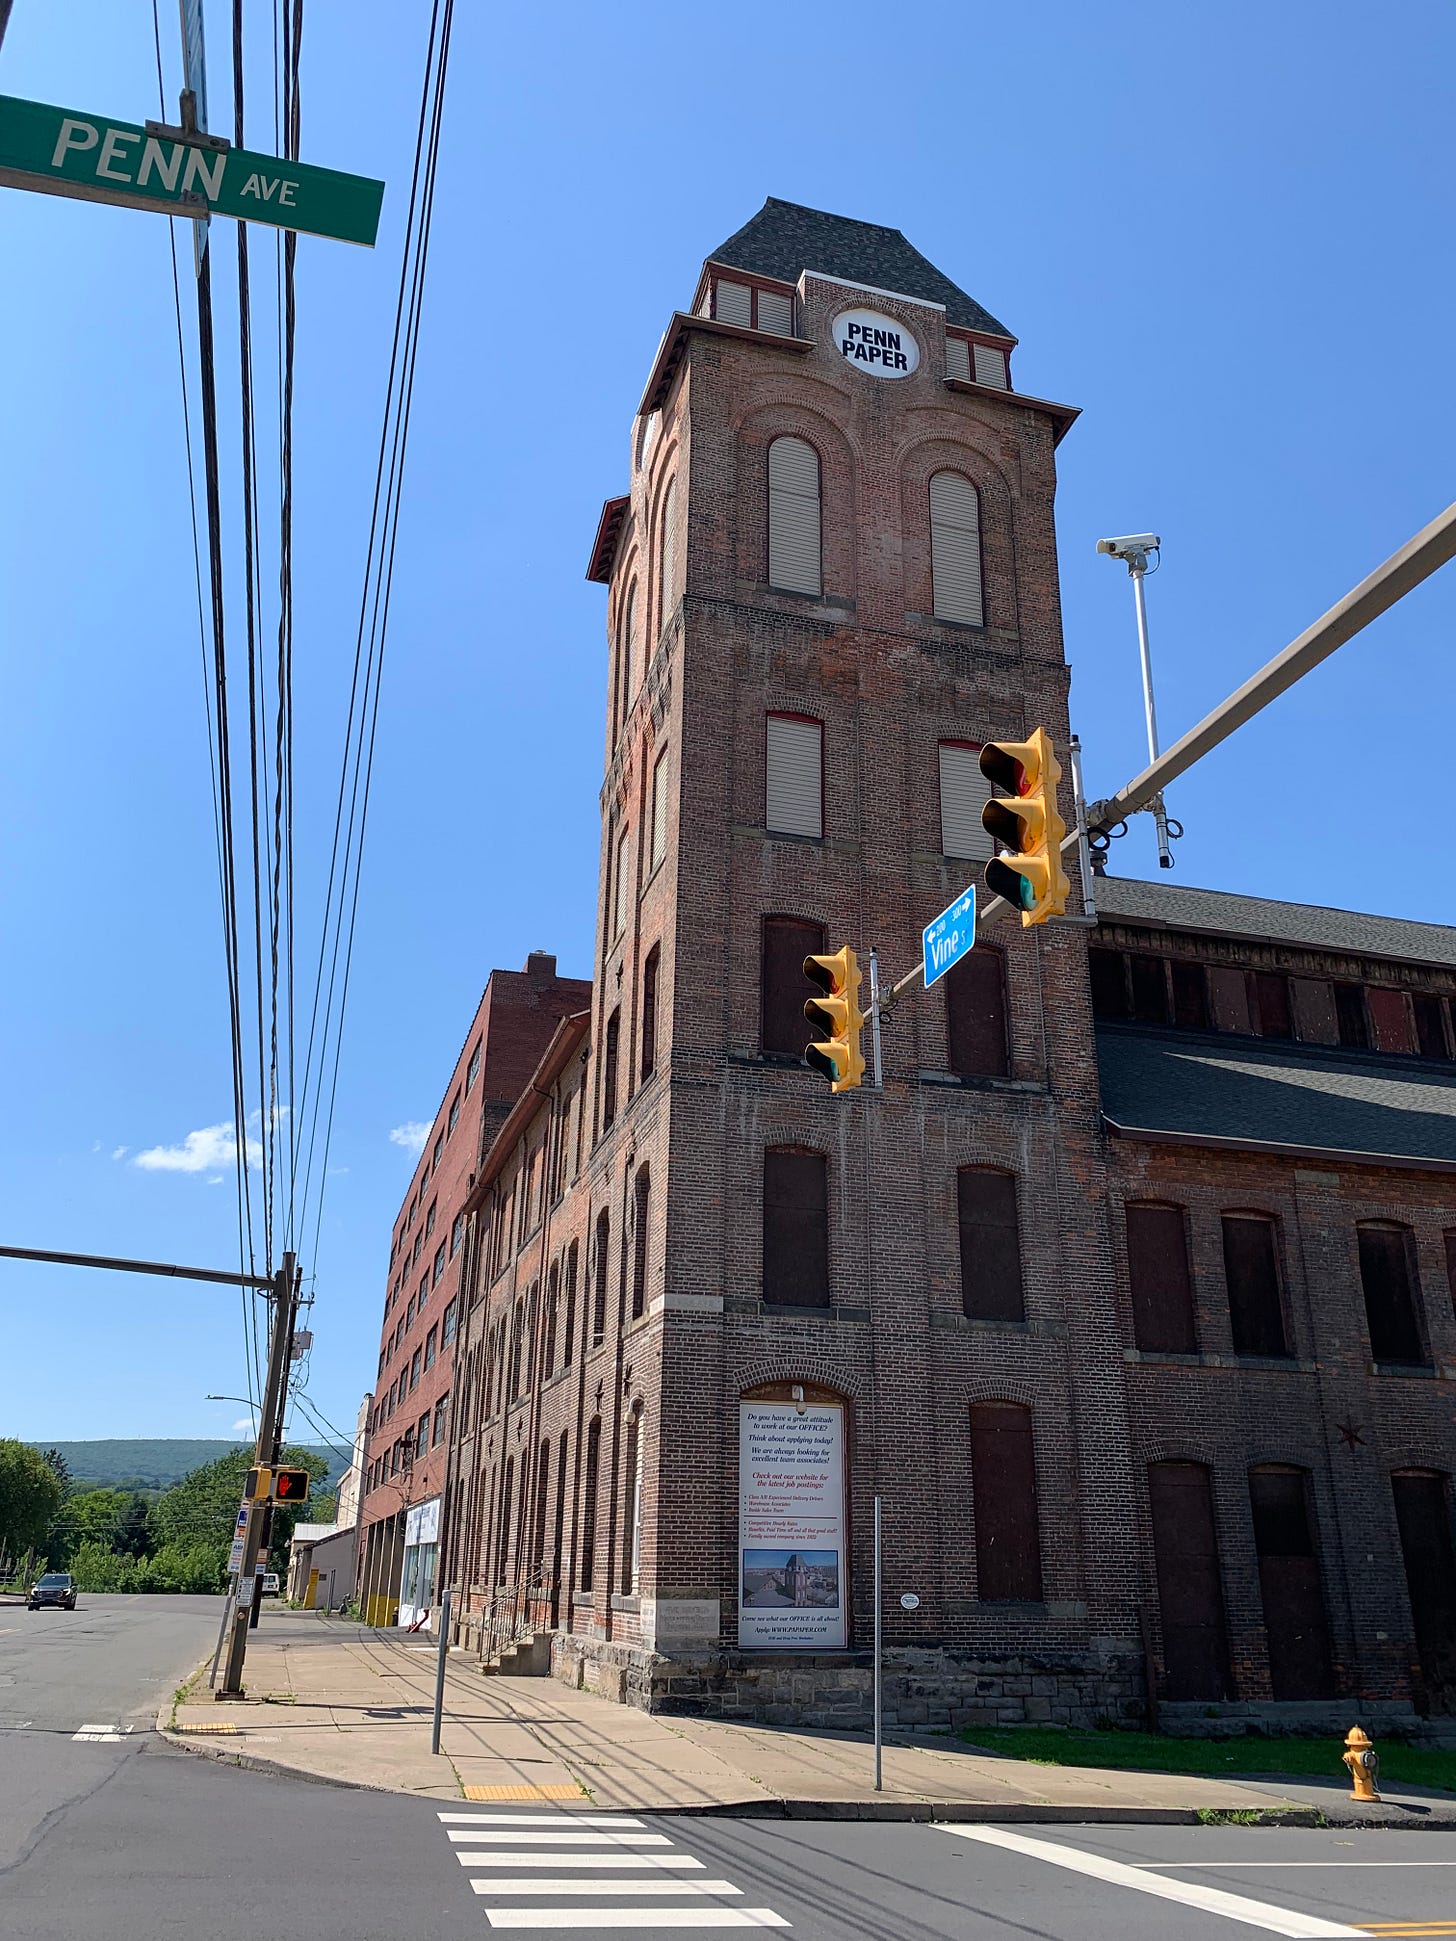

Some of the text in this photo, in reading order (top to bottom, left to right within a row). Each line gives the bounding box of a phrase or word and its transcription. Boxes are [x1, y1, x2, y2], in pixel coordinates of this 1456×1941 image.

[51, 118, 299, 206] PENN AVE
[848, 322, 901, 351] PENN
[842, 339, 908, 371] PAPER
[936, 905, 961, 936] 200 300
[931, 930, 958, 970] Vine
[773, 1448, 795, 1456] always
[796, 1448, 820, 1457] looking
[786, 1436, 813, 1444] applying
[813, 1437, 834, 1445] today!
[795, 1473, 818, 1481] website
[818, 1473, 829, 1481] for
[796, 1481, 824, 1489] postings:
